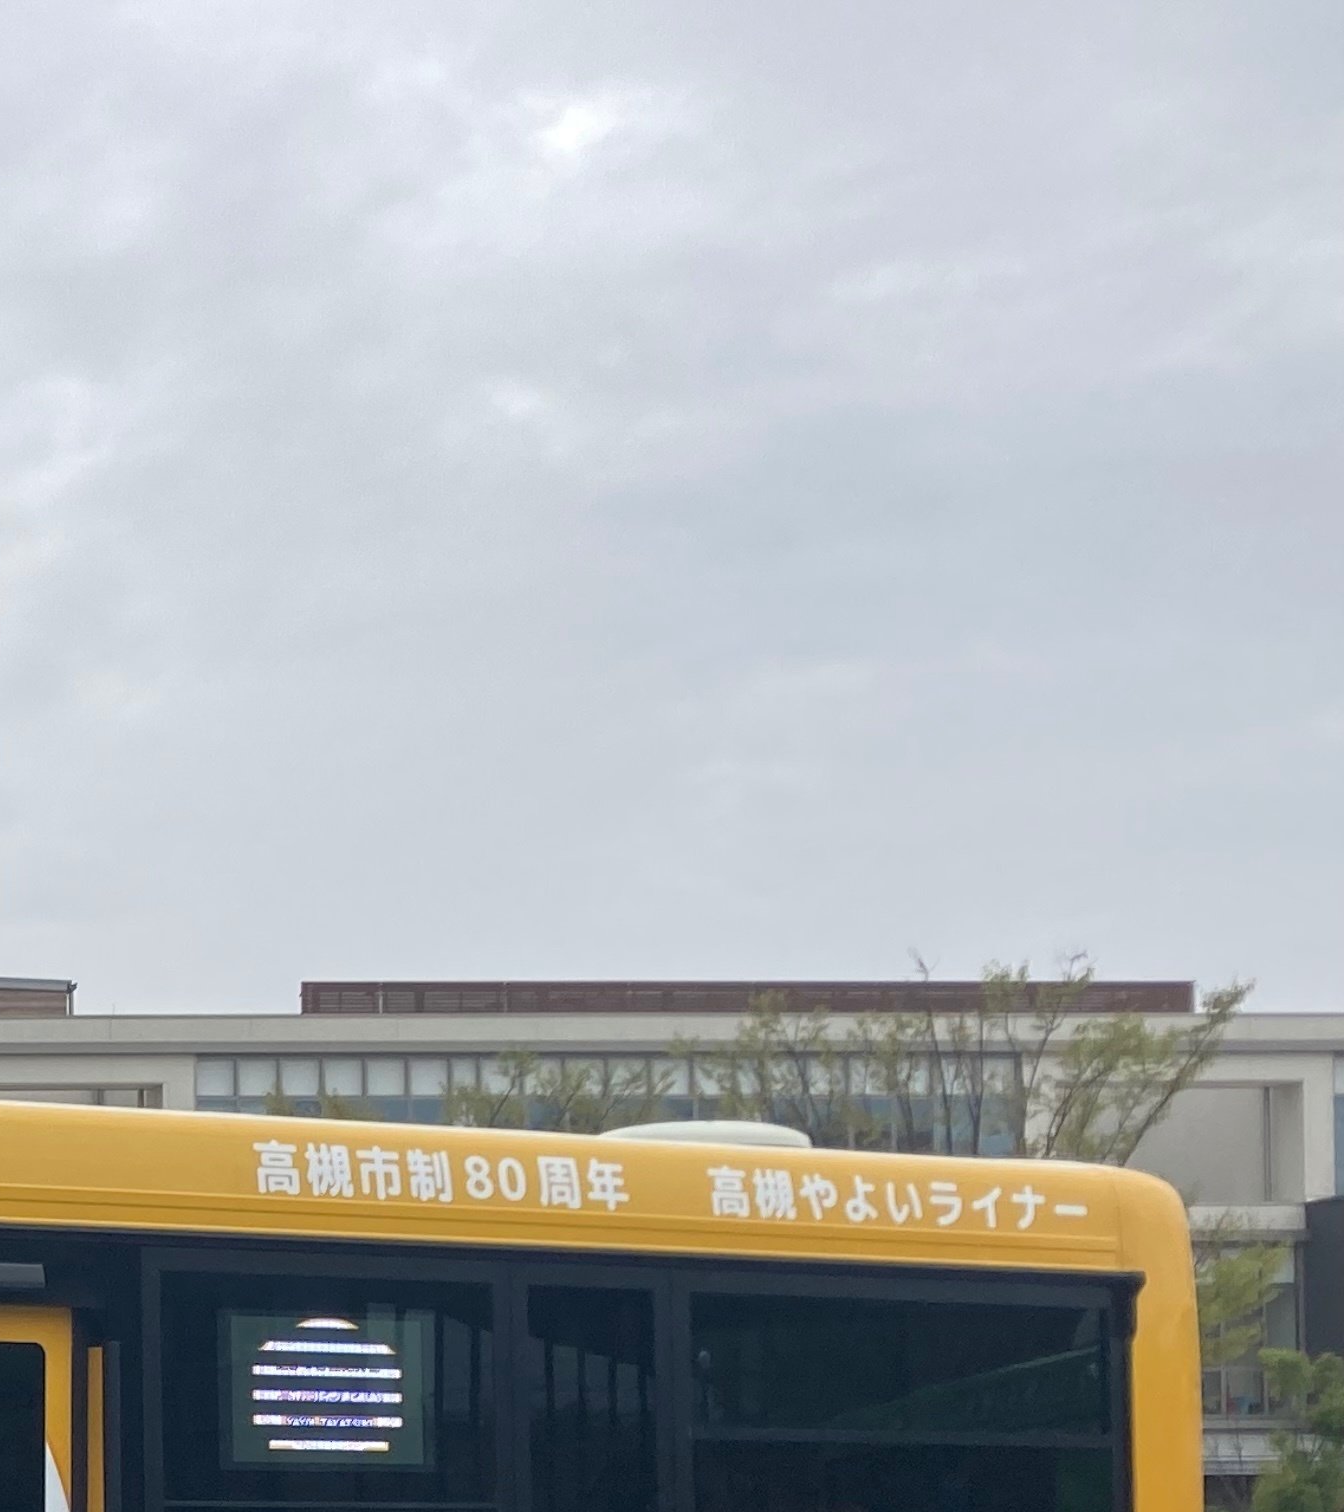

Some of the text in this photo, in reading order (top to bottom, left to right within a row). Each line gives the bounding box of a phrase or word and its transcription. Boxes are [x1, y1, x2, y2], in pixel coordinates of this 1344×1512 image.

[707, 1165, 1088, 1230] 高槻やよいライナー
